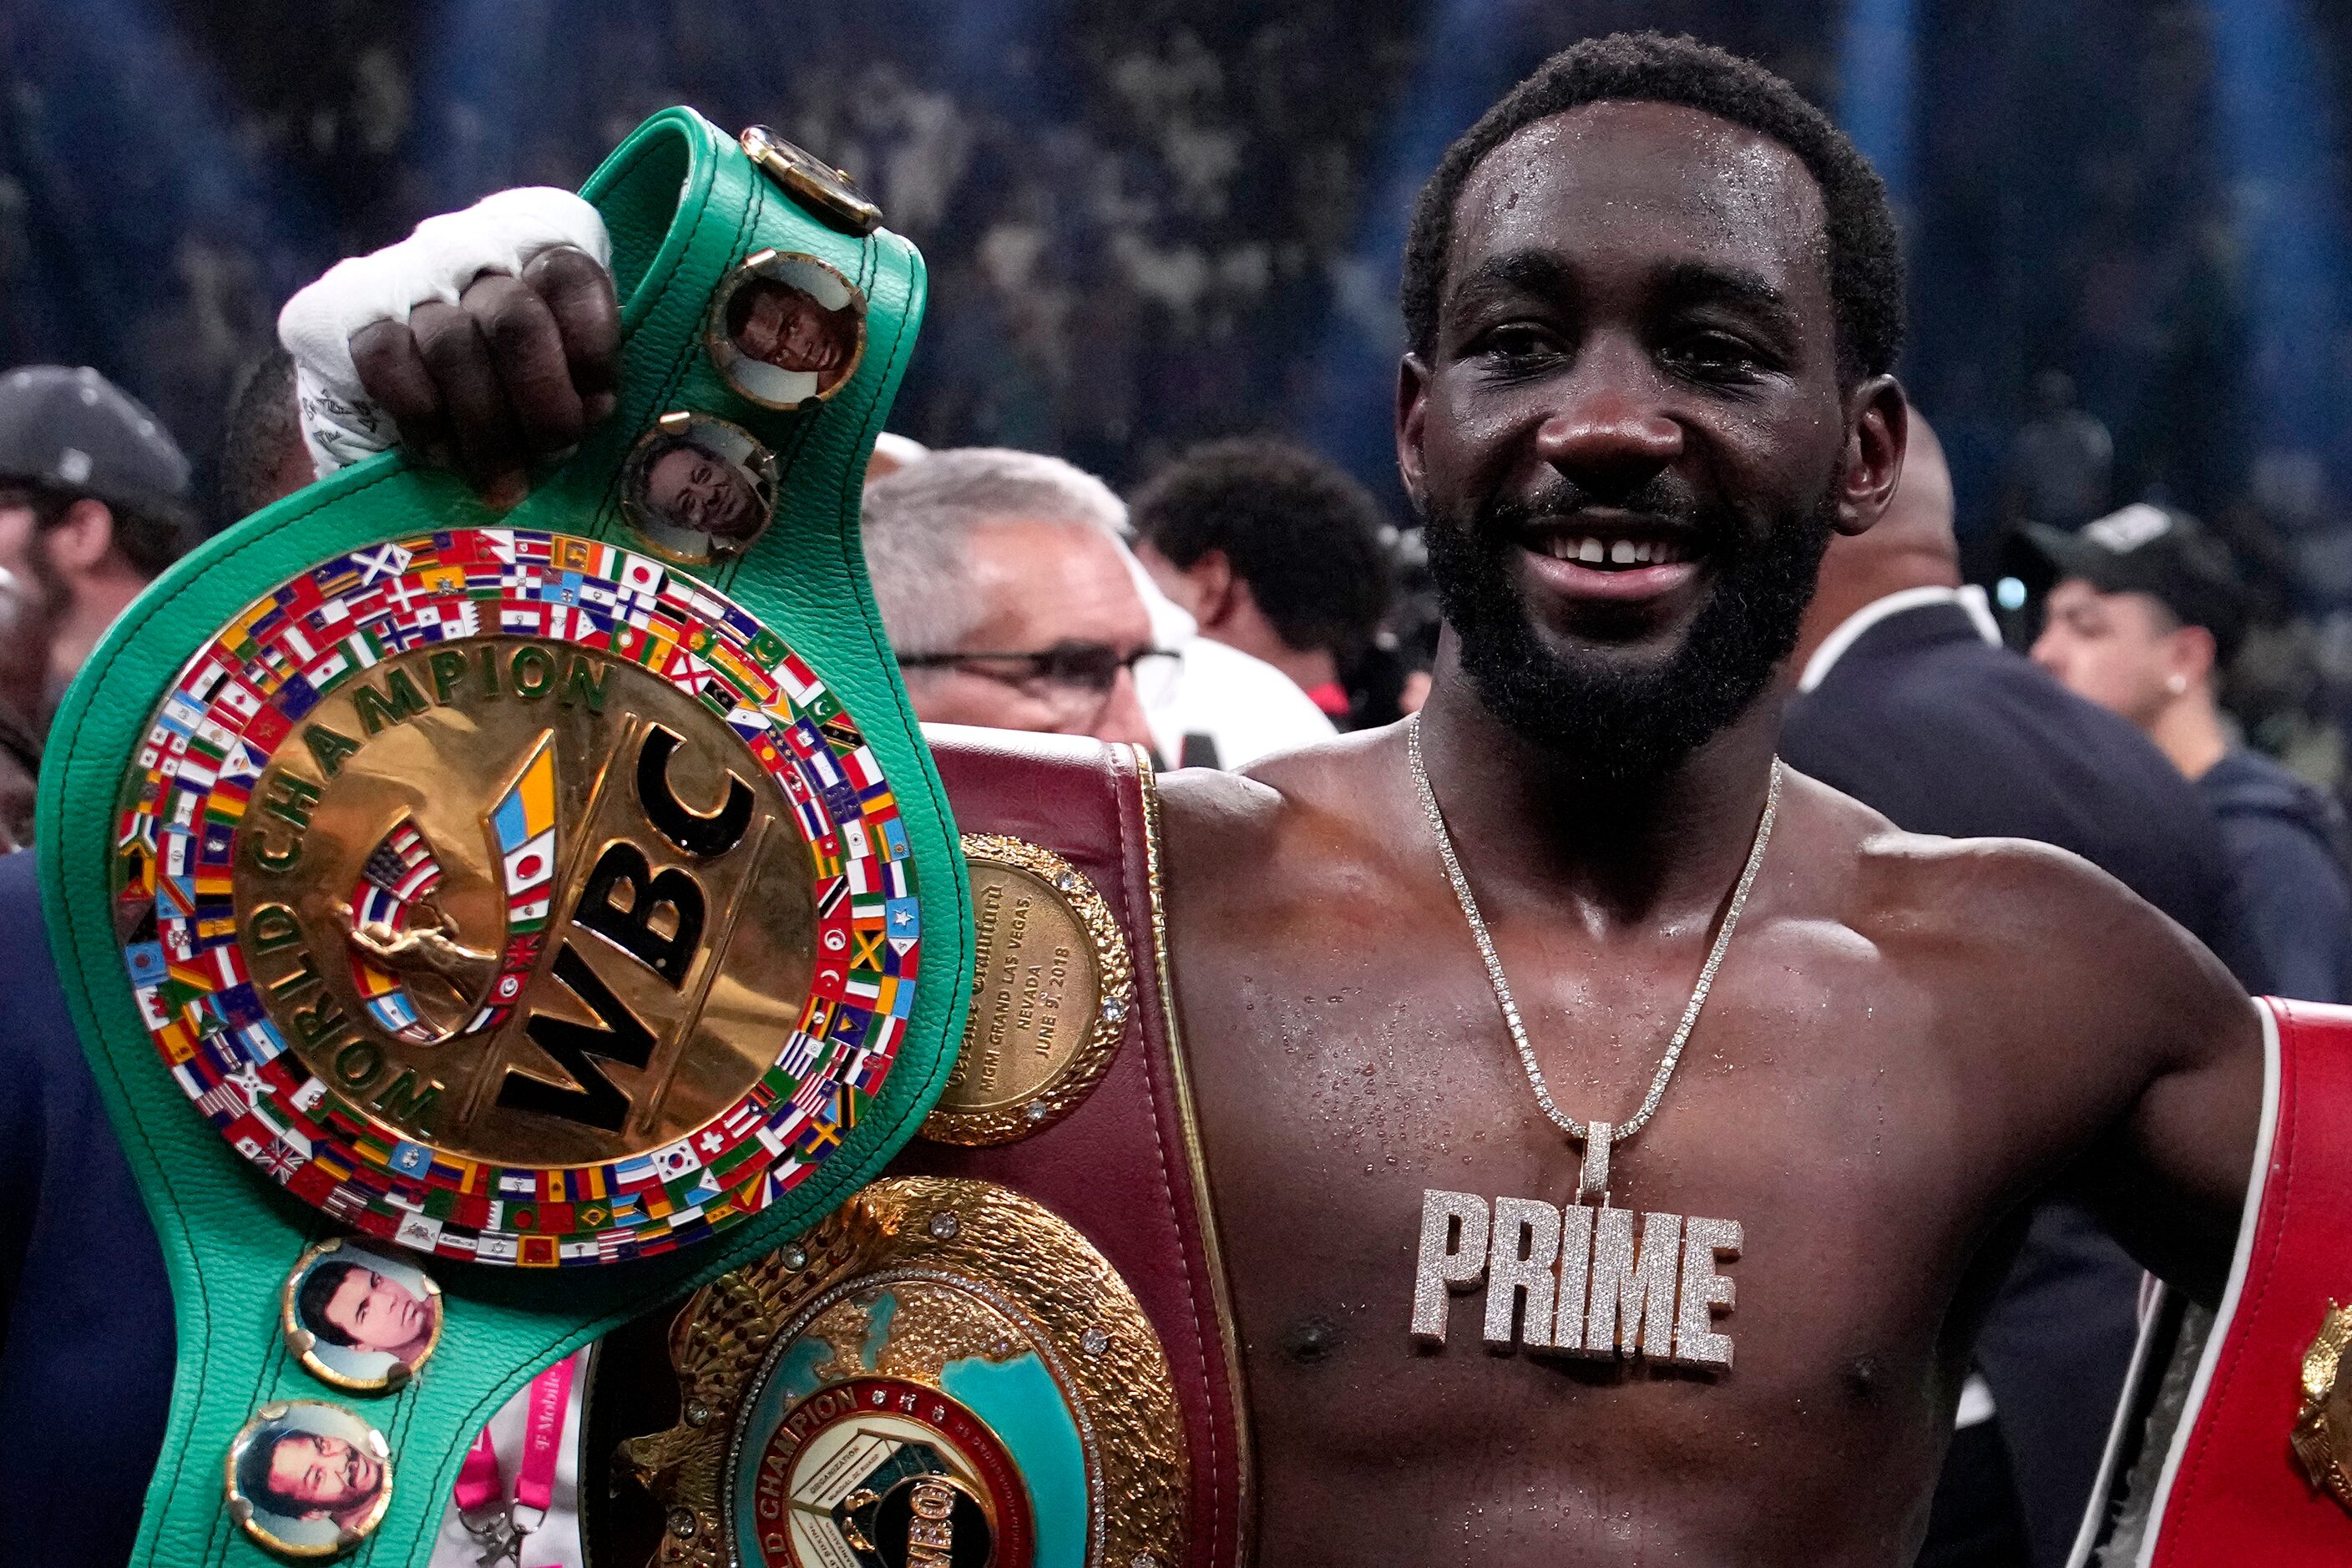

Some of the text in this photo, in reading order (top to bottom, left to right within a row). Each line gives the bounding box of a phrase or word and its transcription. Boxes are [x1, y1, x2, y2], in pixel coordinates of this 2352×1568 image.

[252, 646, 621, 1137] WORLD CHAMPION
[497, 721, 756, 1135] WBC
[980, 895, 1033, 1091] MGM GRAND LAS VEGAS,
[1017, 964, 1042, 1030] NEVADA
[1035, 1014, 1056, 1059] JUNE
[1050, 946, 1070, 989] 2018
[1410, 1189, 1744, 1372] PRIME
[760, 1386, 858, 1520] CHAMPION
